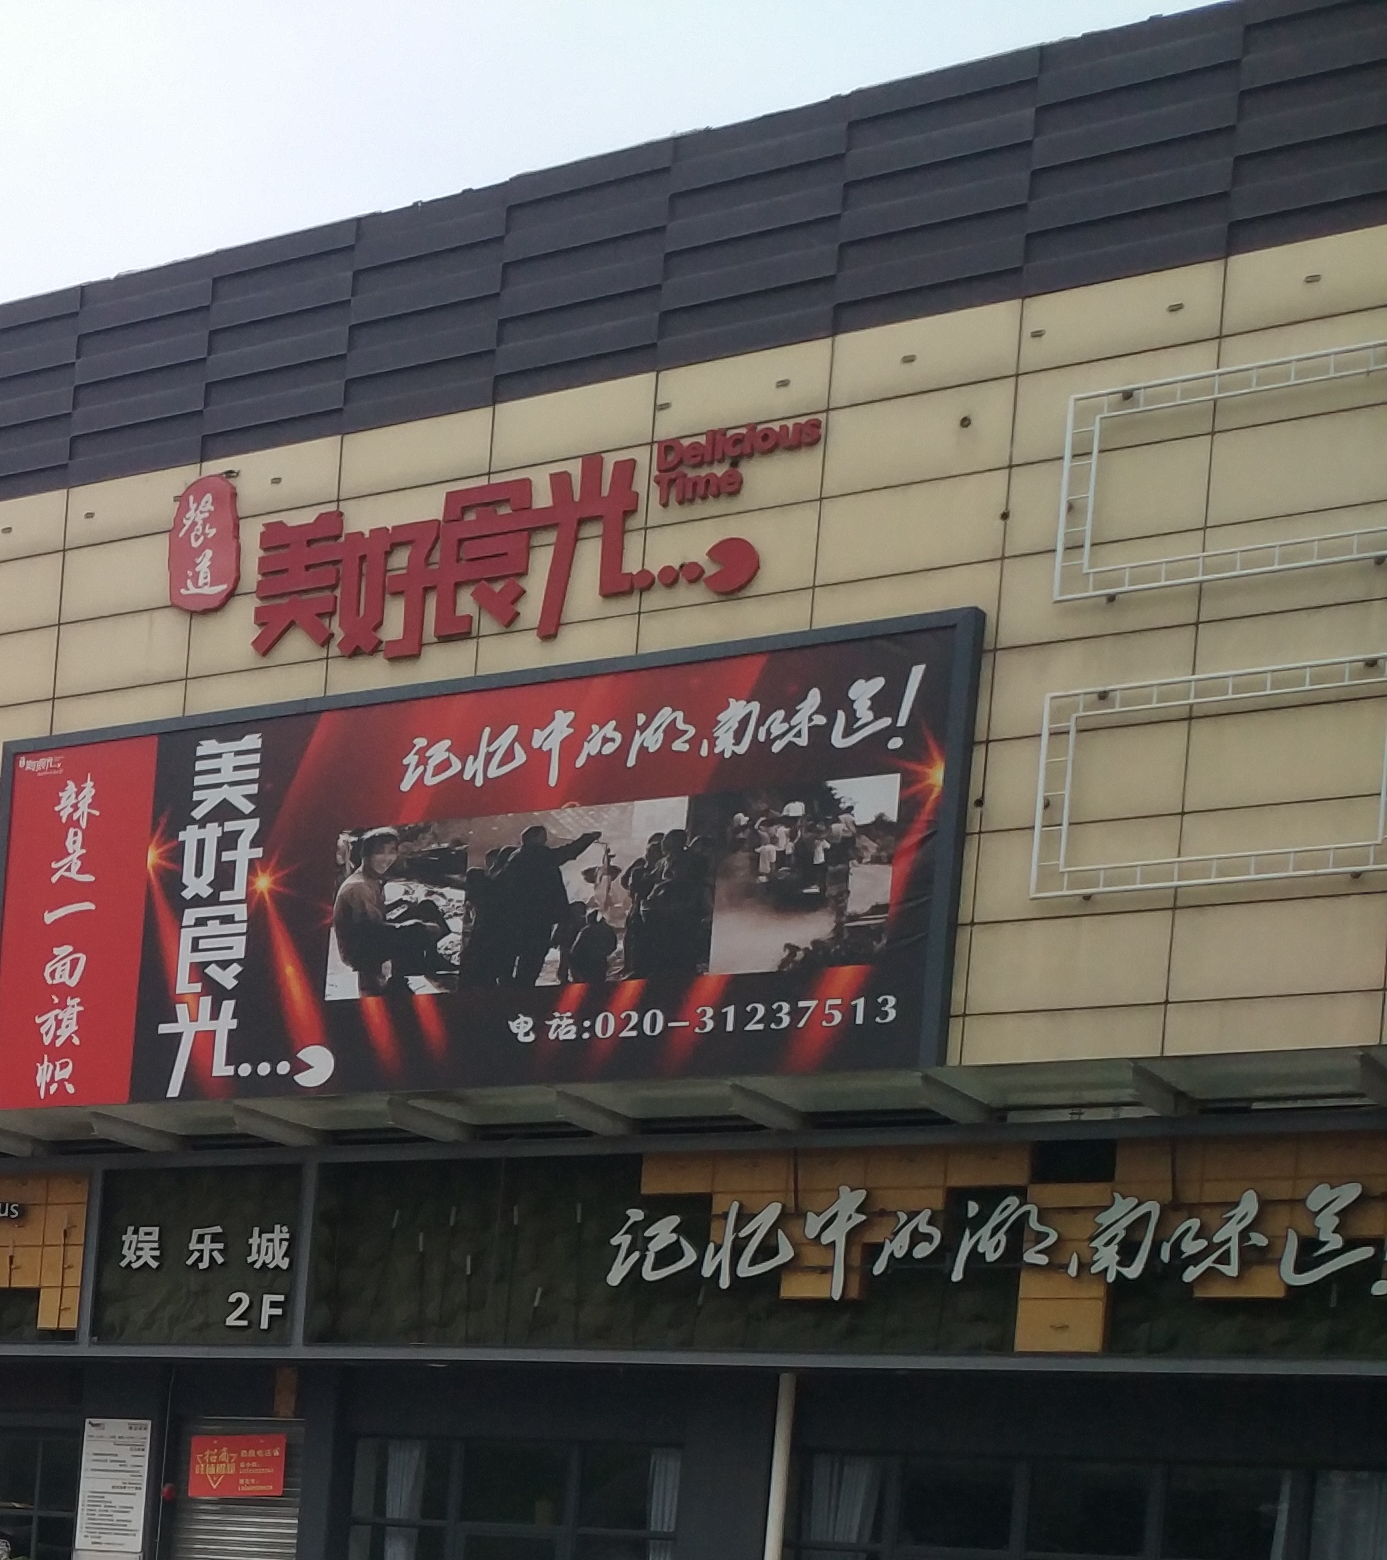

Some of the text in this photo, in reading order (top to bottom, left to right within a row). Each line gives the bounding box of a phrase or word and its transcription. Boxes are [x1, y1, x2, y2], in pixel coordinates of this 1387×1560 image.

[655, 416, 822, 474] Delicious
[654, 462, 743, 507] Time
[35, 772, 101, 1100] 辣是一面旗帜
[120, 1224, 291, 1272] 娱乐城
[606, 1181, 1387, 1300] 记忆中的湖南味道
[225, 1291, 286, 1331] 2F
